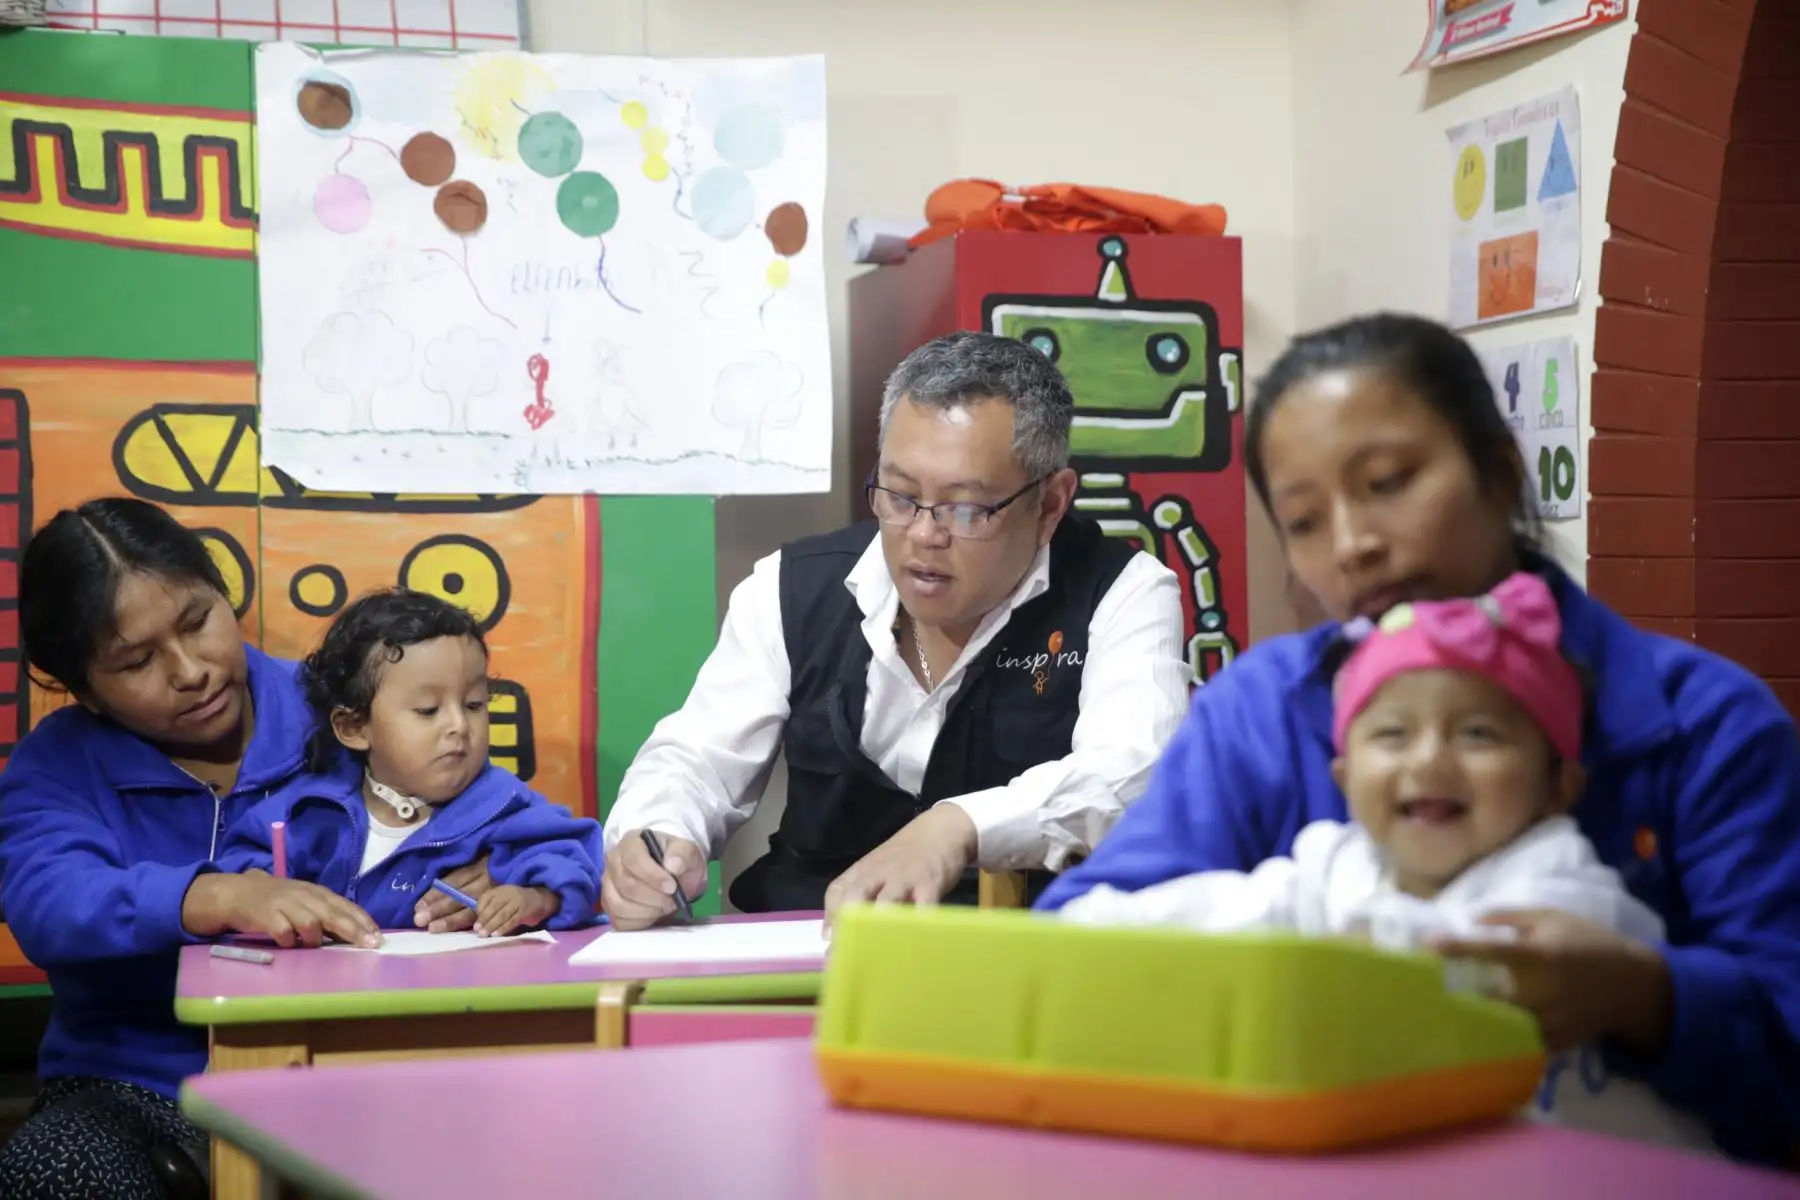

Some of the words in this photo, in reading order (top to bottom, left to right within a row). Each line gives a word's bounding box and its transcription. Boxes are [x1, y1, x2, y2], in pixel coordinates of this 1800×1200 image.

[1504, 360, 1520, 414] 4
[1542, 357, 1559, 412] 5
[1538, 444, 1576, 502] 10
[995, 640, 1083, 674] inspira
